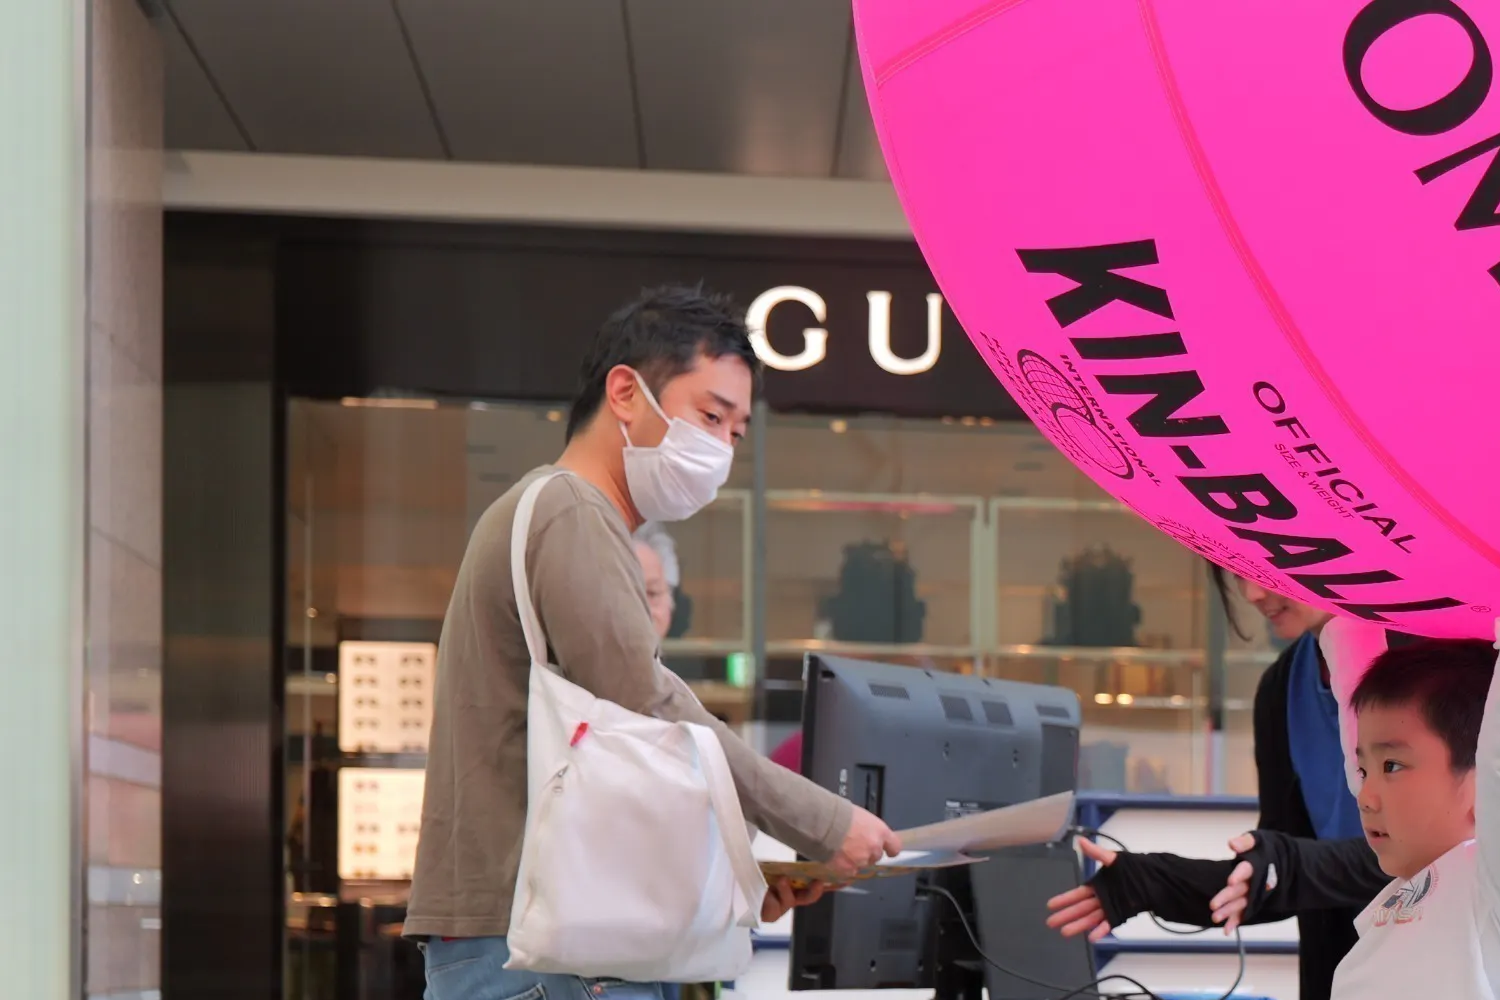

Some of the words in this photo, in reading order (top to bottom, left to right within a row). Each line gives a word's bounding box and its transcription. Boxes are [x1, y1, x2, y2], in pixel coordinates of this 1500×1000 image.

[1060, 353, 1162, 488] INTERNATIONAL
[1252, 381, 1416, 554] OFFICIAL
[1274, 443, 1302, 469] SIZE
[1297, 471, 1310, 480] &
[1308, 480, 1356, 519] WEIGHT
